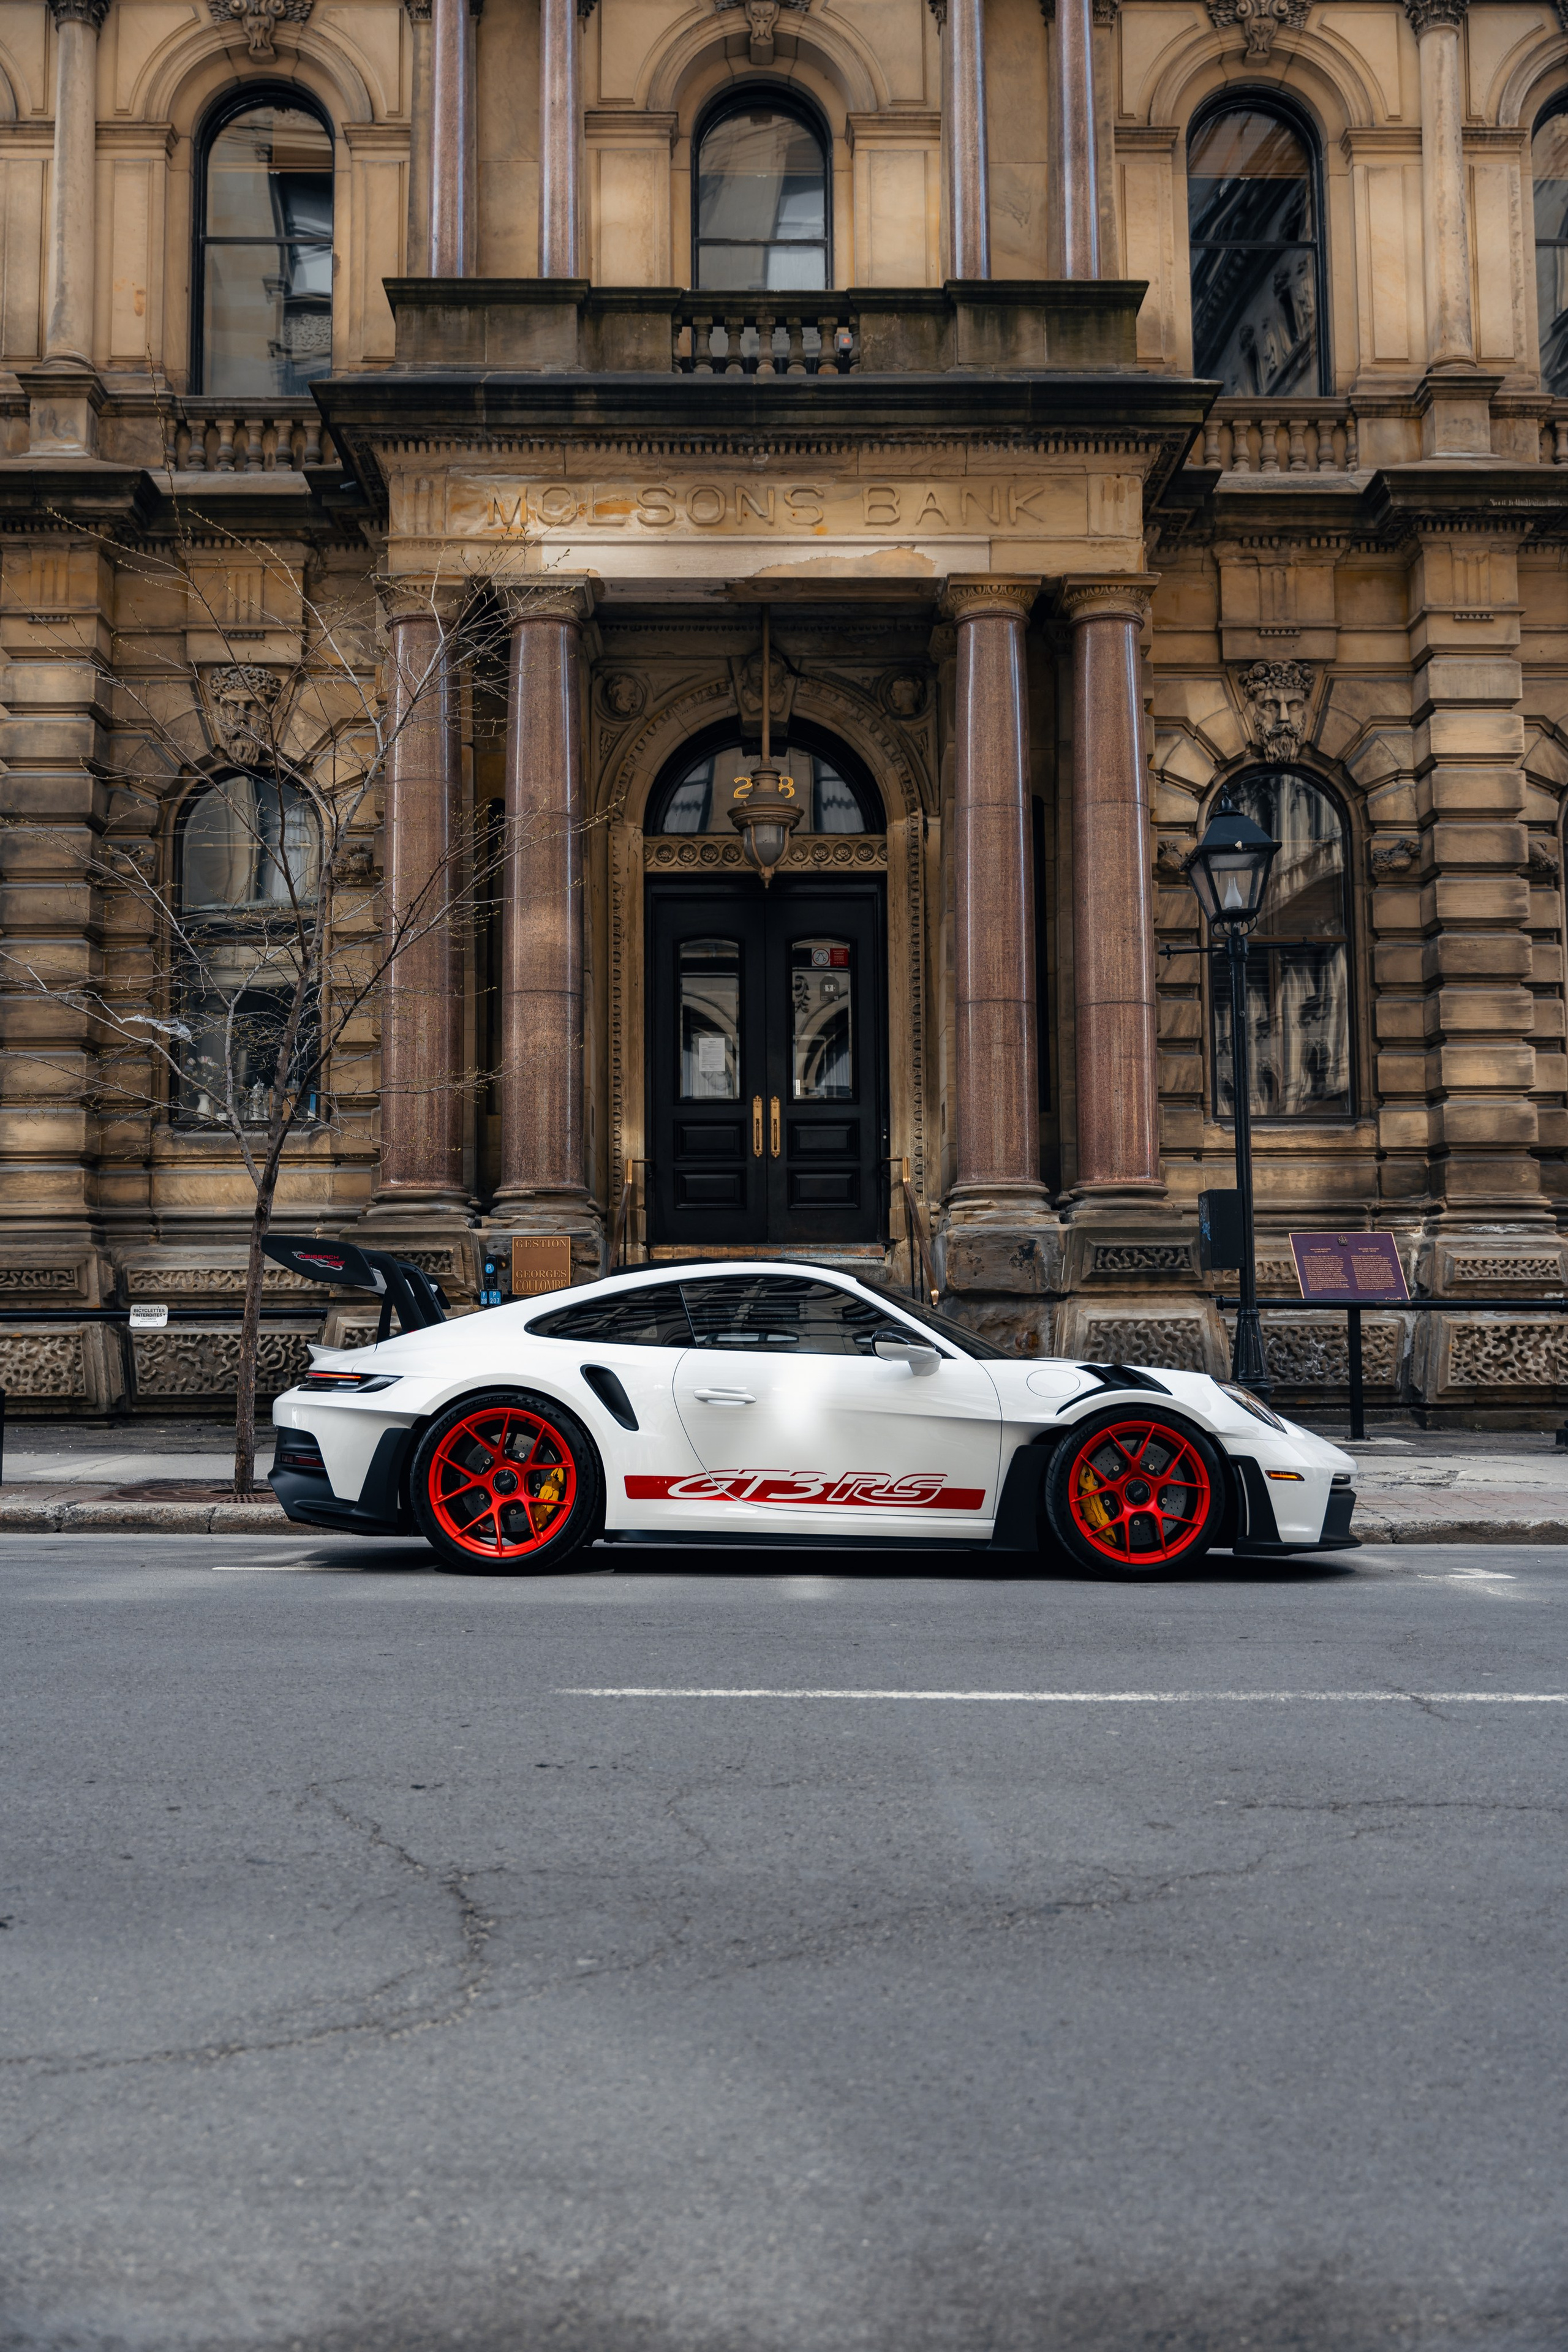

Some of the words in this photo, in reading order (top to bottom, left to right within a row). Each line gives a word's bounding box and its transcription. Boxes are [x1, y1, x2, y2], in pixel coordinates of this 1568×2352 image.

[488, 484, 824, 527] MOLSONS
[862, 484, 1045, 527] BANK
[733, 776, 796, 799] 28
[516, 1240, 567, 1248] GESTION
[516, 1270, 567, 1278] GEORGES
